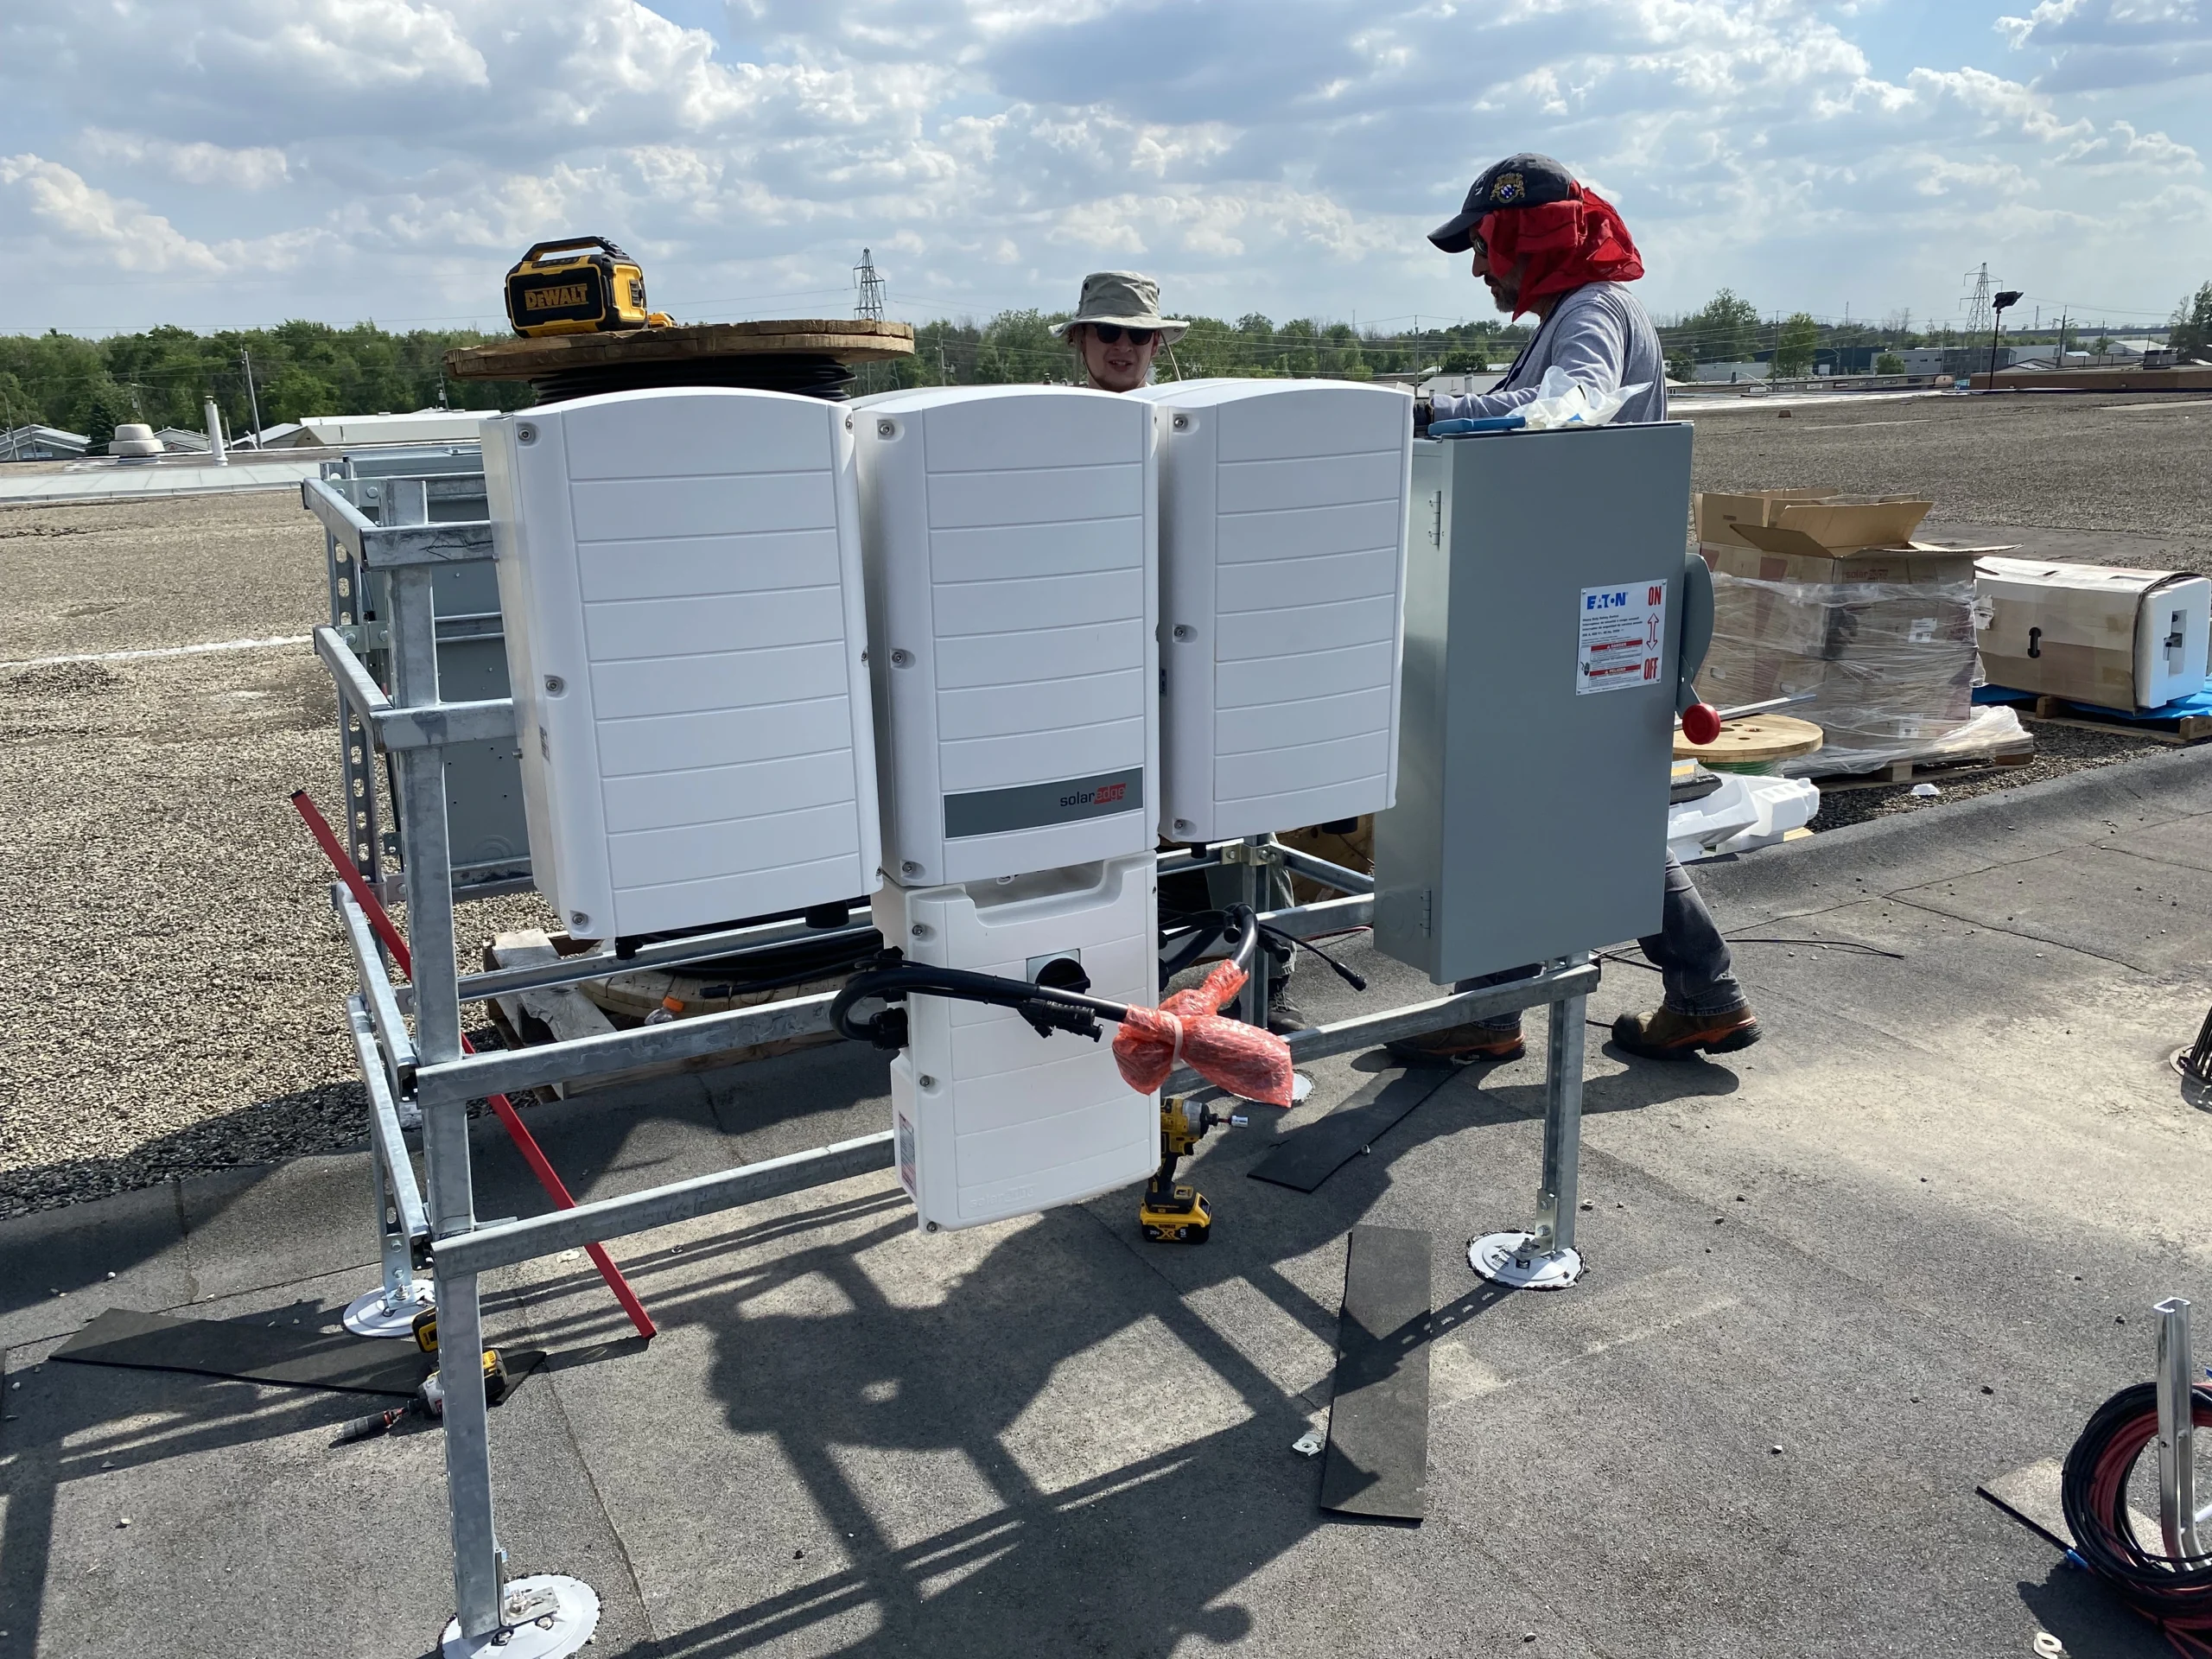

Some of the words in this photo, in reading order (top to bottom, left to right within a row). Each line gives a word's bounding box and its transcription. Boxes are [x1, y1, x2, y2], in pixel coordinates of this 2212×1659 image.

[1586, 592, 1626, 610] EATON
[1648, 586, 1662, 606] ON
[1643, 657, 1659, 680] OFF
[1059, 785, 1125, 806] solaredge
